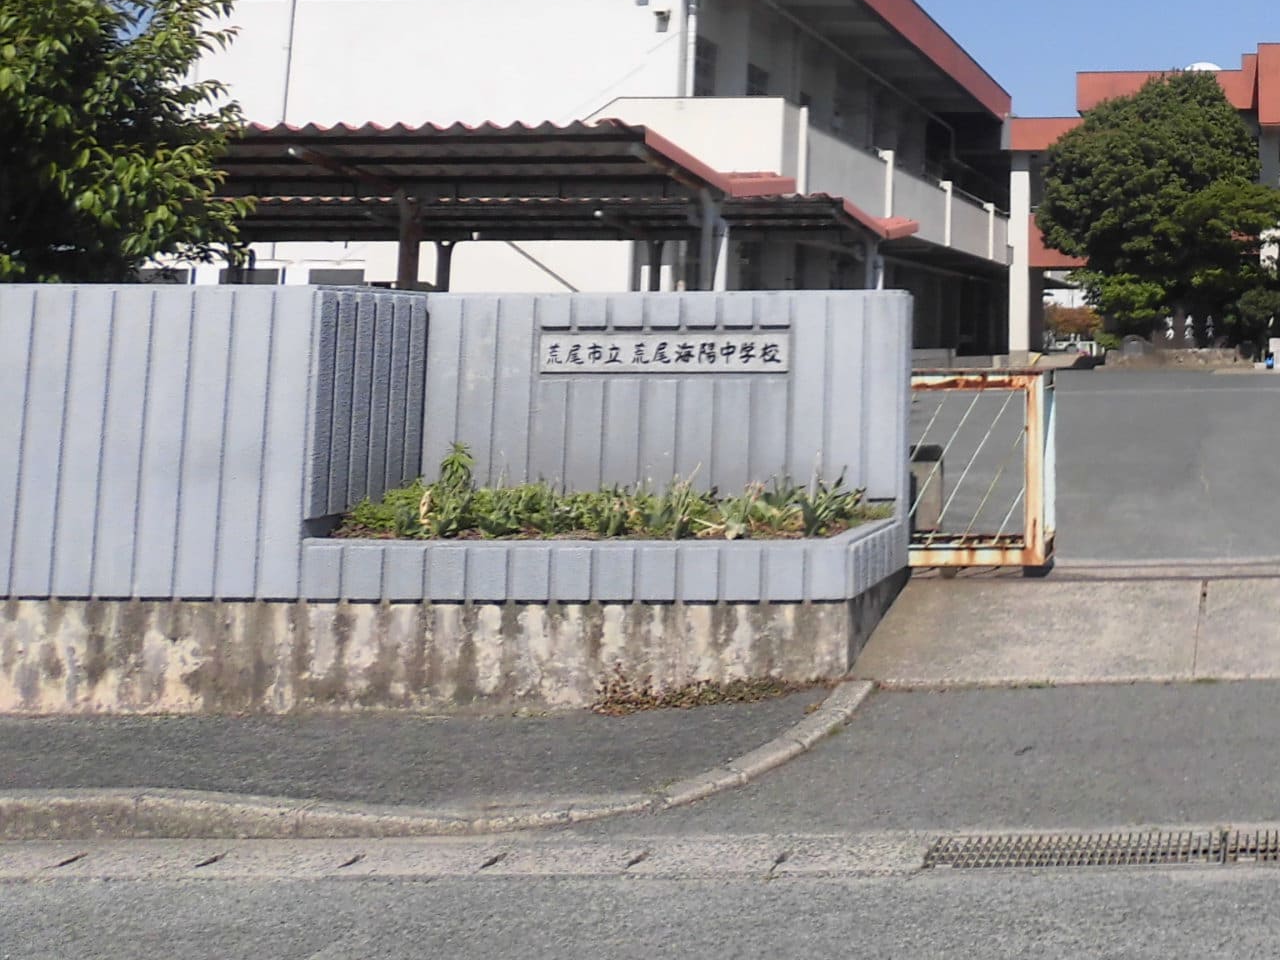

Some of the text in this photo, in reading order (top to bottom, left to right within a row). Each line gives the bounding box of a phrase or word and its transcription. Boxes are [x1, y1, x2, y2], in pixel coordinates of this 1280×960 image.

[546, 342, 781, 364] 荒尾市立 荒尾海陽中学校
